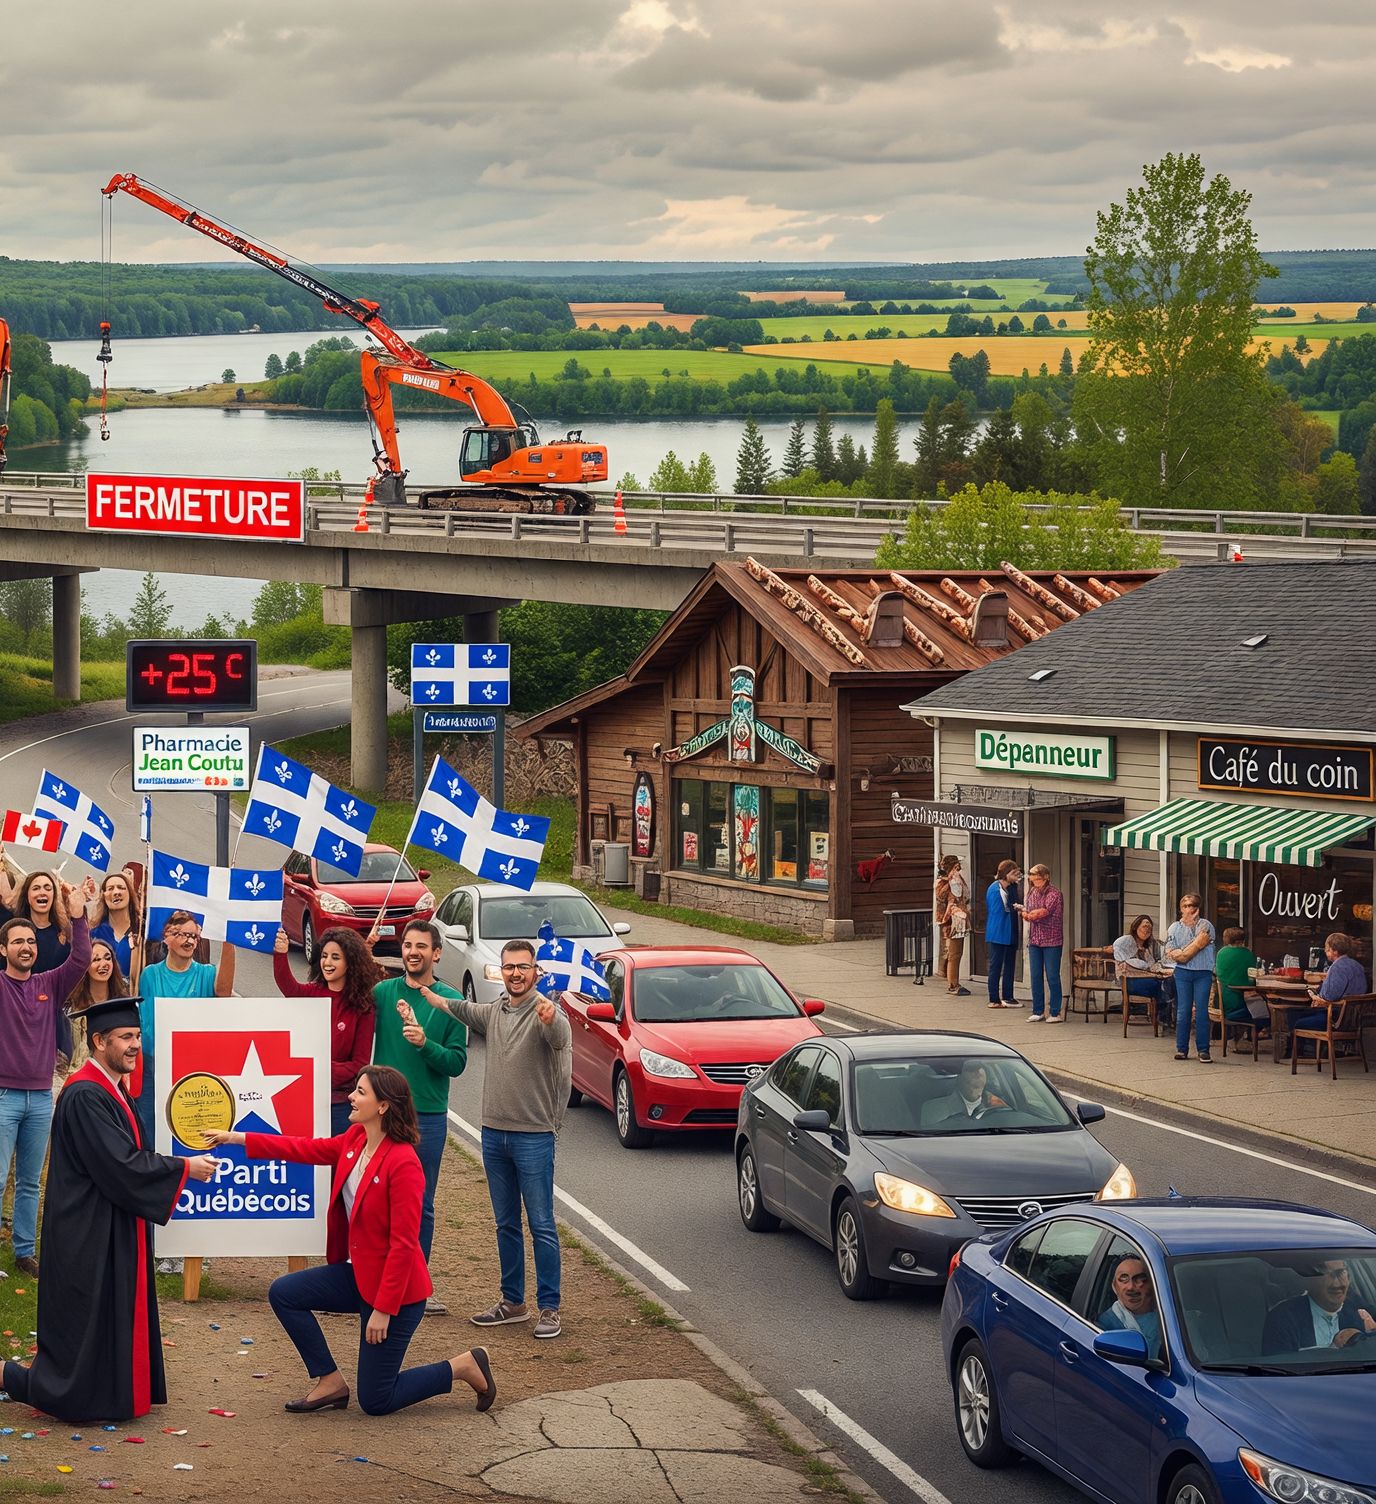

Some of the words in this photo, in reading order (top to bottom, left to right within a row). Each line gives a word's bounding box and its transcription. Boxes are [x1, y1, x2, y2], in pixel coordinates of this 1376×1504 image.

[96, 484, 290, 527] FERMETURE
[142, 653, 216, 694] +25
[138, 754, 183, 771] Jean
[188, 754, 243, 771] Coutu
[142, 734, 242, 752] Pharmacie
[980, 732, 1103, 769] Dépanneur
[1208, 745, 1259, 788] Café
[1268, 753, 1298, 785] du
[1307, 756, 1359, 790] coin
[1258, 872, 1343, 921] Ouvert
[214, 1157, 287, 1185] Parti
